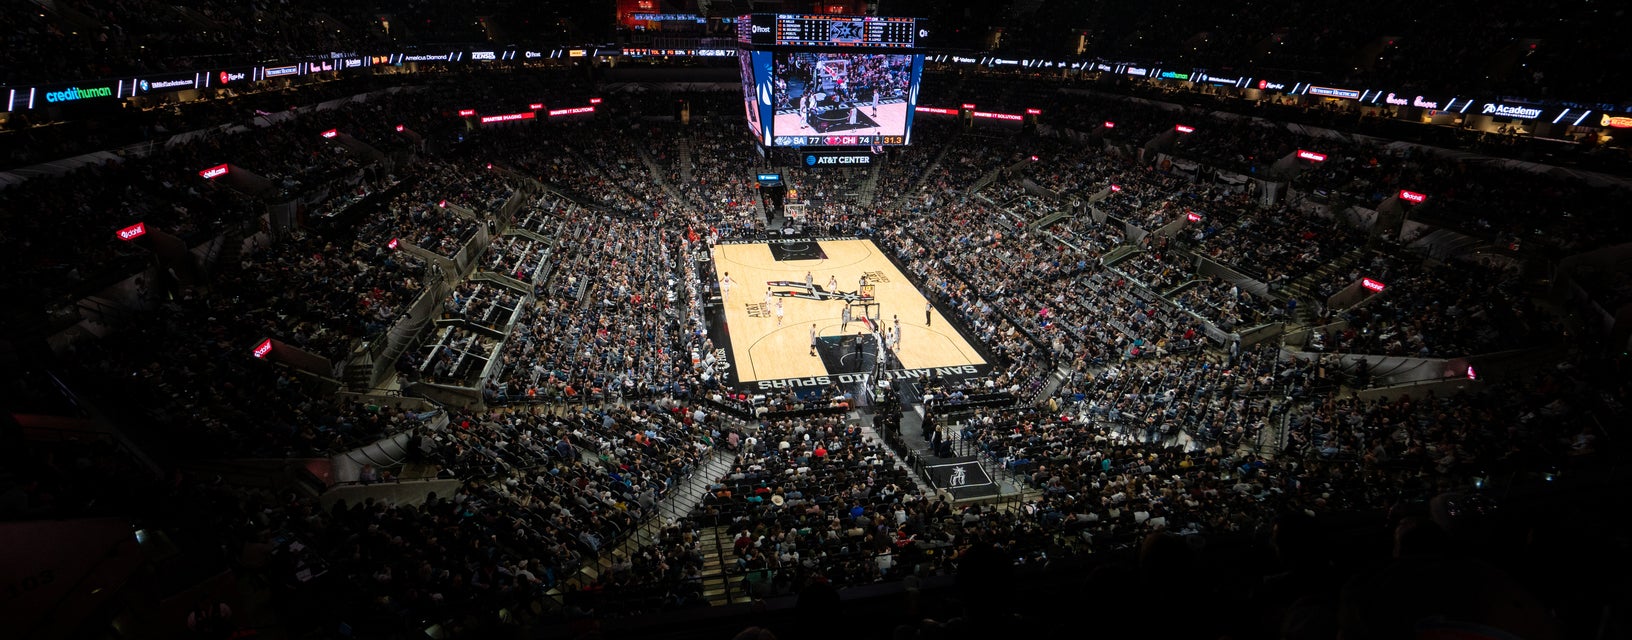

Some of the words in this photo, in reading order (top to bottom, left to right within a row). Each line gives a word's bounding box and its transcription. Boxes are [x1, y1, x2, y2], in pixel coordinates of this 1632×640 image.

[46, 85, 111, 102] credithuman
[1496, 104, 1542, 118] Academy
[884, 136, 902, 144] 31.3
[817, 156, 837, 164] AT&T
[838, 156, 869, 164] CENTER
[757, 375, 832, 390] SPURS
